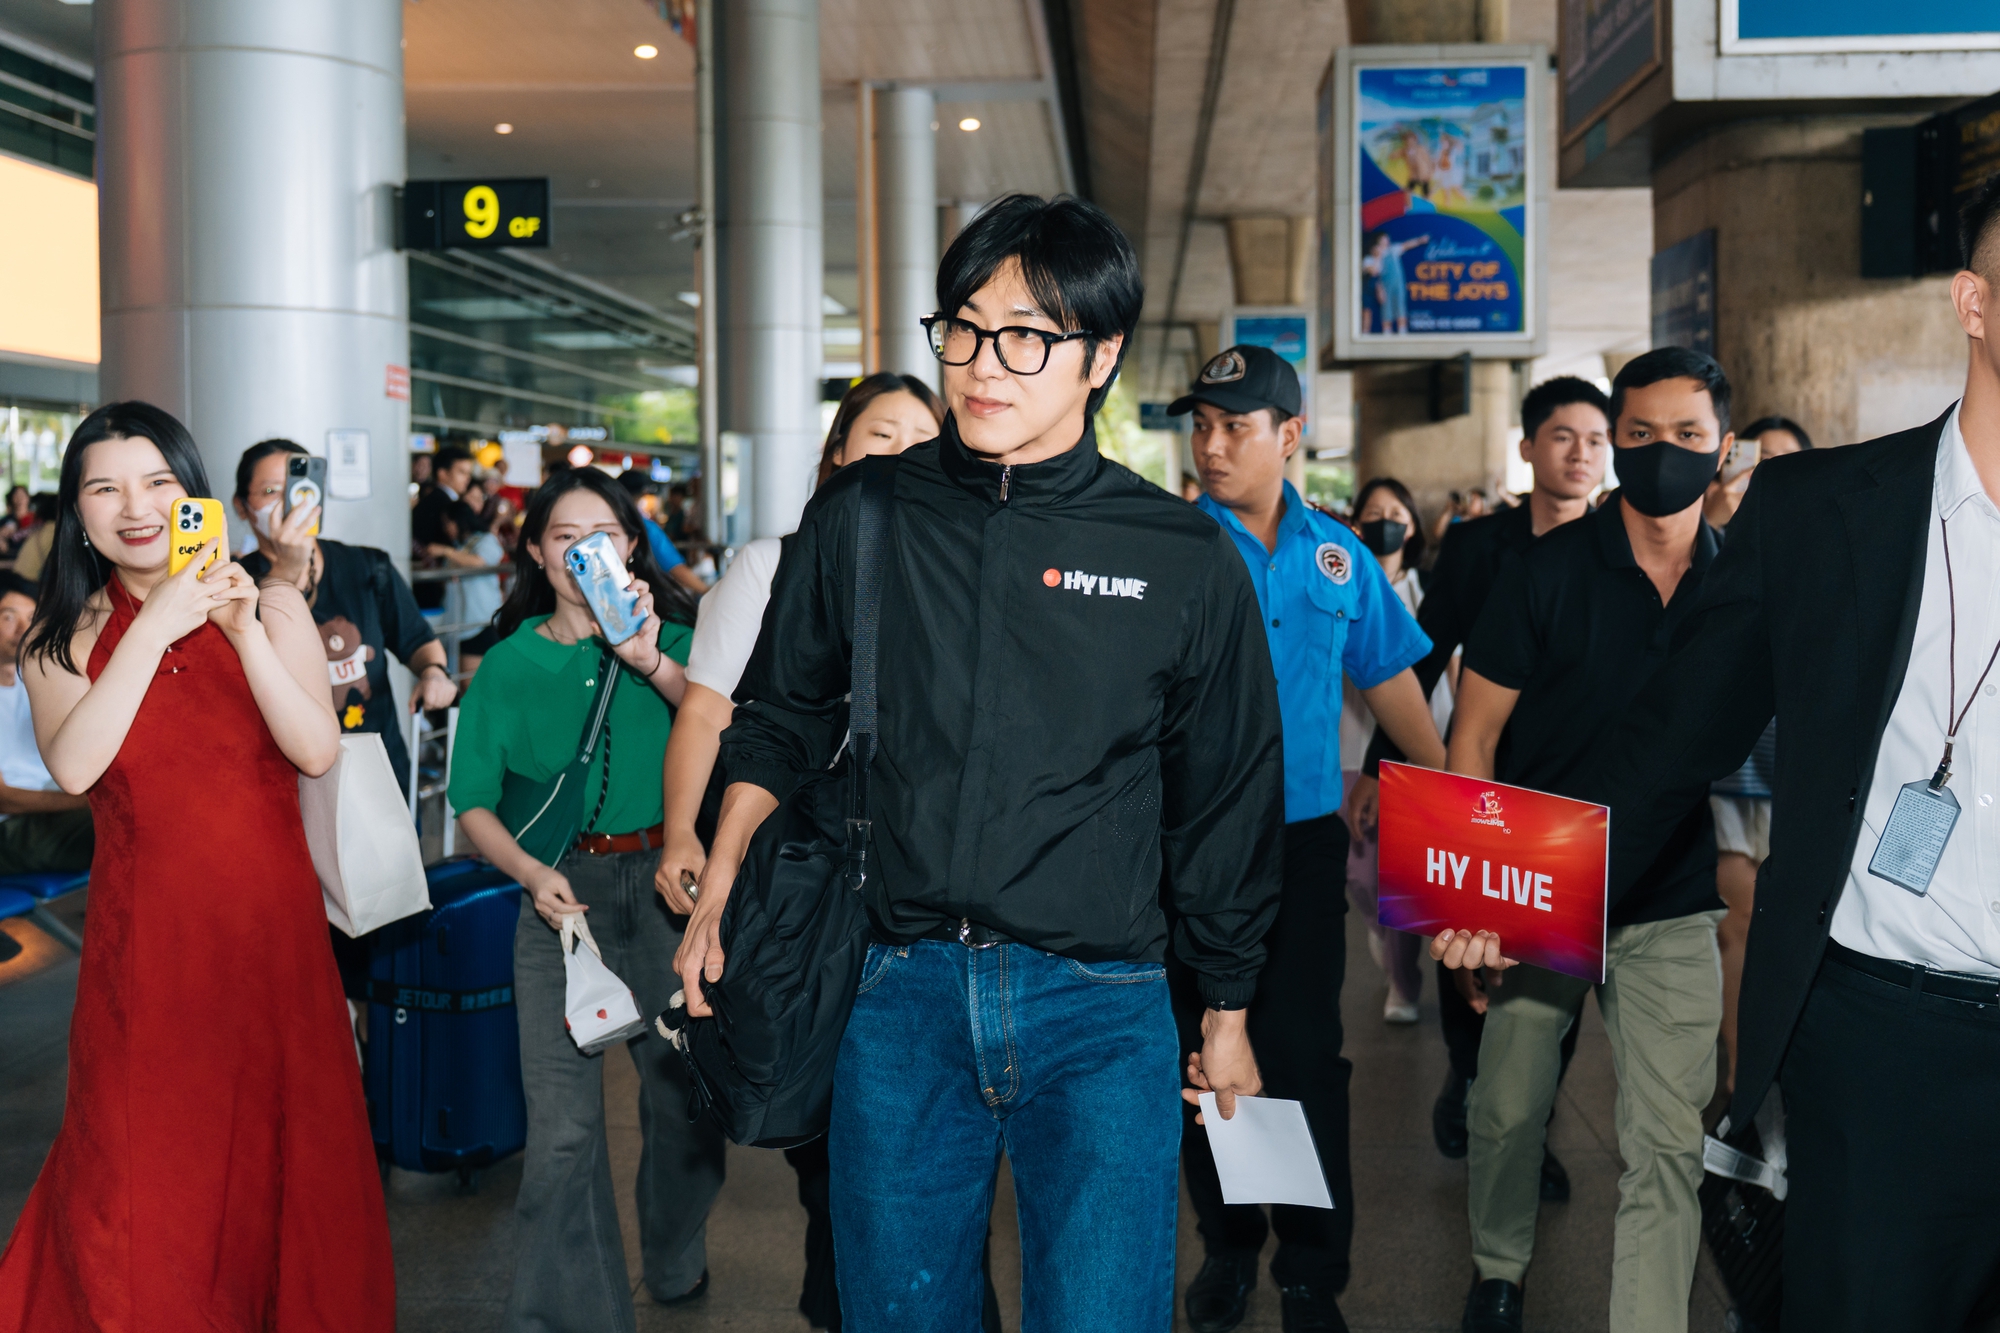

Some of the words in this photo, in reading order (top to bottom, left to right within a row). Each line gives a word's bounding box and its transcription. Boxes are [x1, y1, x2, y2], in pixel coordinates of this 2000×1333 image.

[462, 185, 500, 239] 9
[1415, 261, 1465, 280] CITY
[1468, 261, 1500, 280] OF
[1408, 281, 1451, 301] THE
[1454, 281, 1509, 301] JOYS
[1064, 570, 1098, 595] HY
[1099, 576, 1148, 600] LIVE
[335, 659, 356, 680] UT
[1426, 847, 1470, 890] HY
[1482, 860, 1553, 912] LIVE
[393, 988, 452, 1011] JETOUR
